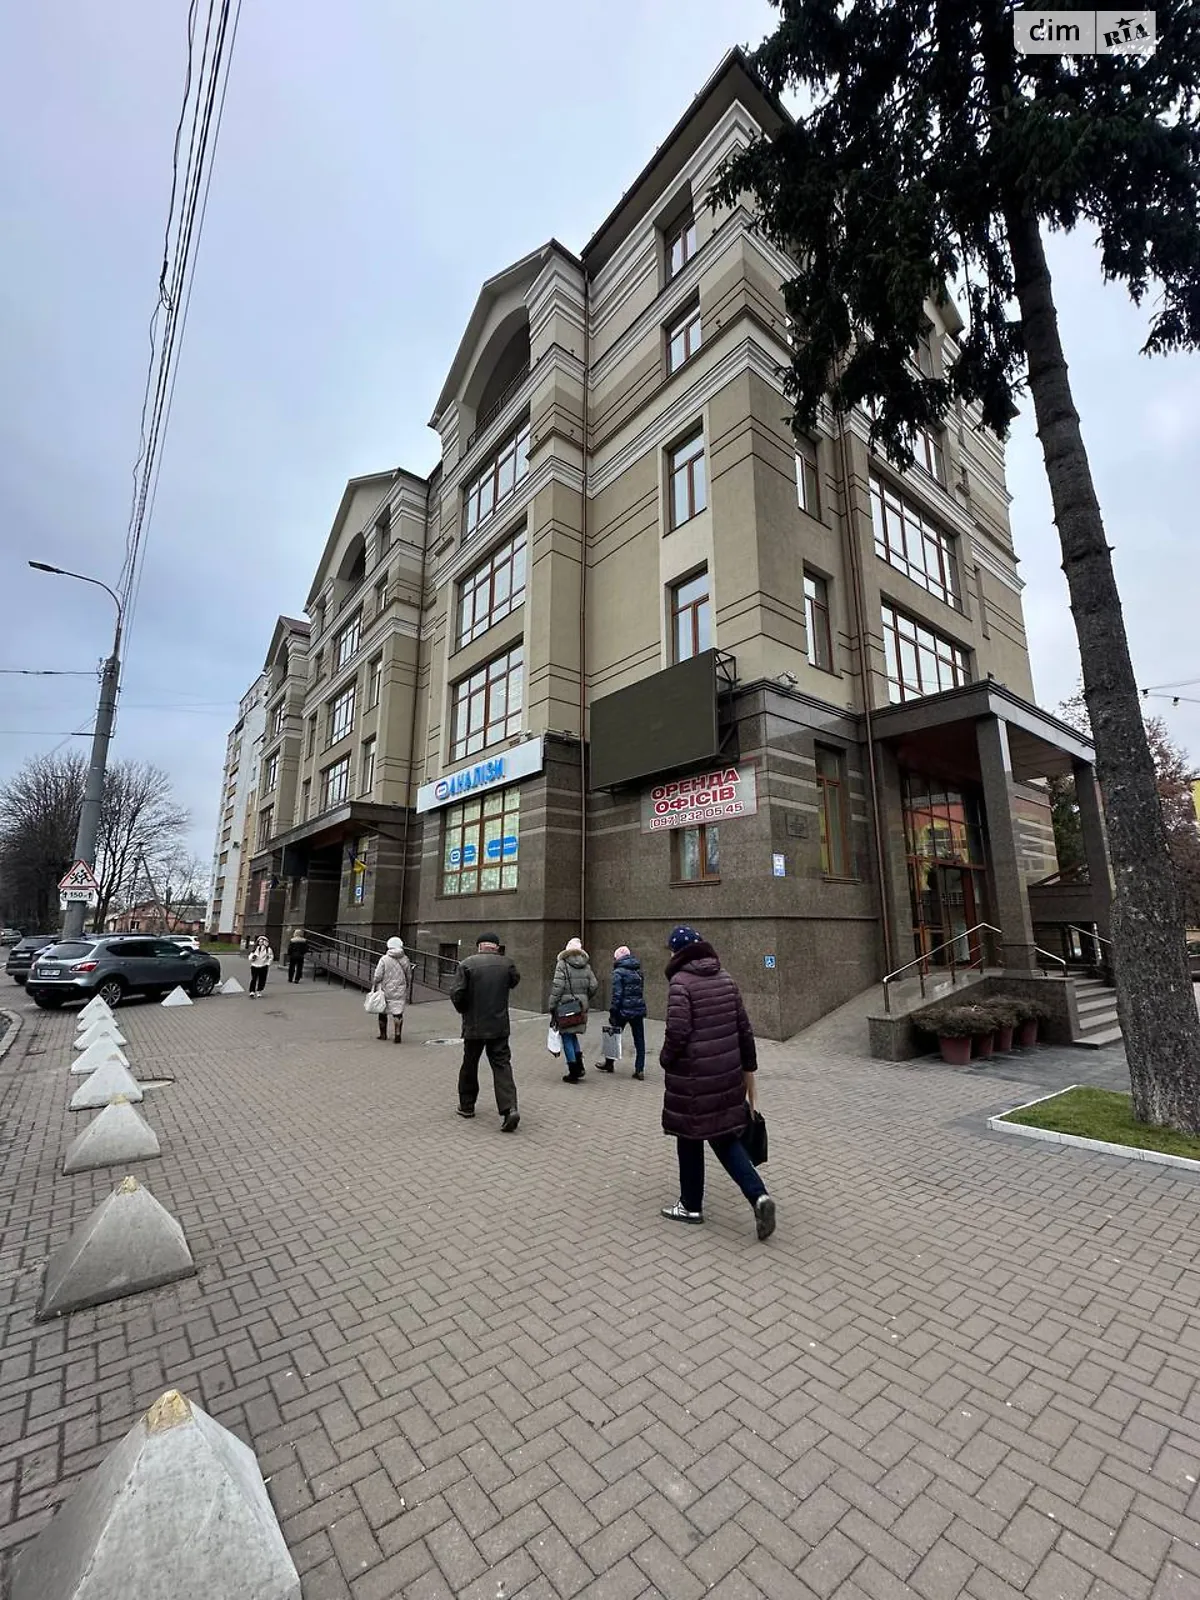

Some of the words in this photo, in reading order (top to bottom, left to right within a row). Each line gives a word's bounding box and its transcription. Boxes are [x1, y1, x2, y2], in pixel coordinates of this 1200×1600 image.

[651, 768, 740, 801] ОРЕНДА
[650, 814, 677, 829] (097)
[680, 810, 703, 822] 232
[704, 806, 722, 818] 05
[725, 801, 743, 814] 45
[655, 785, 736, 815] ОФІСІВ
